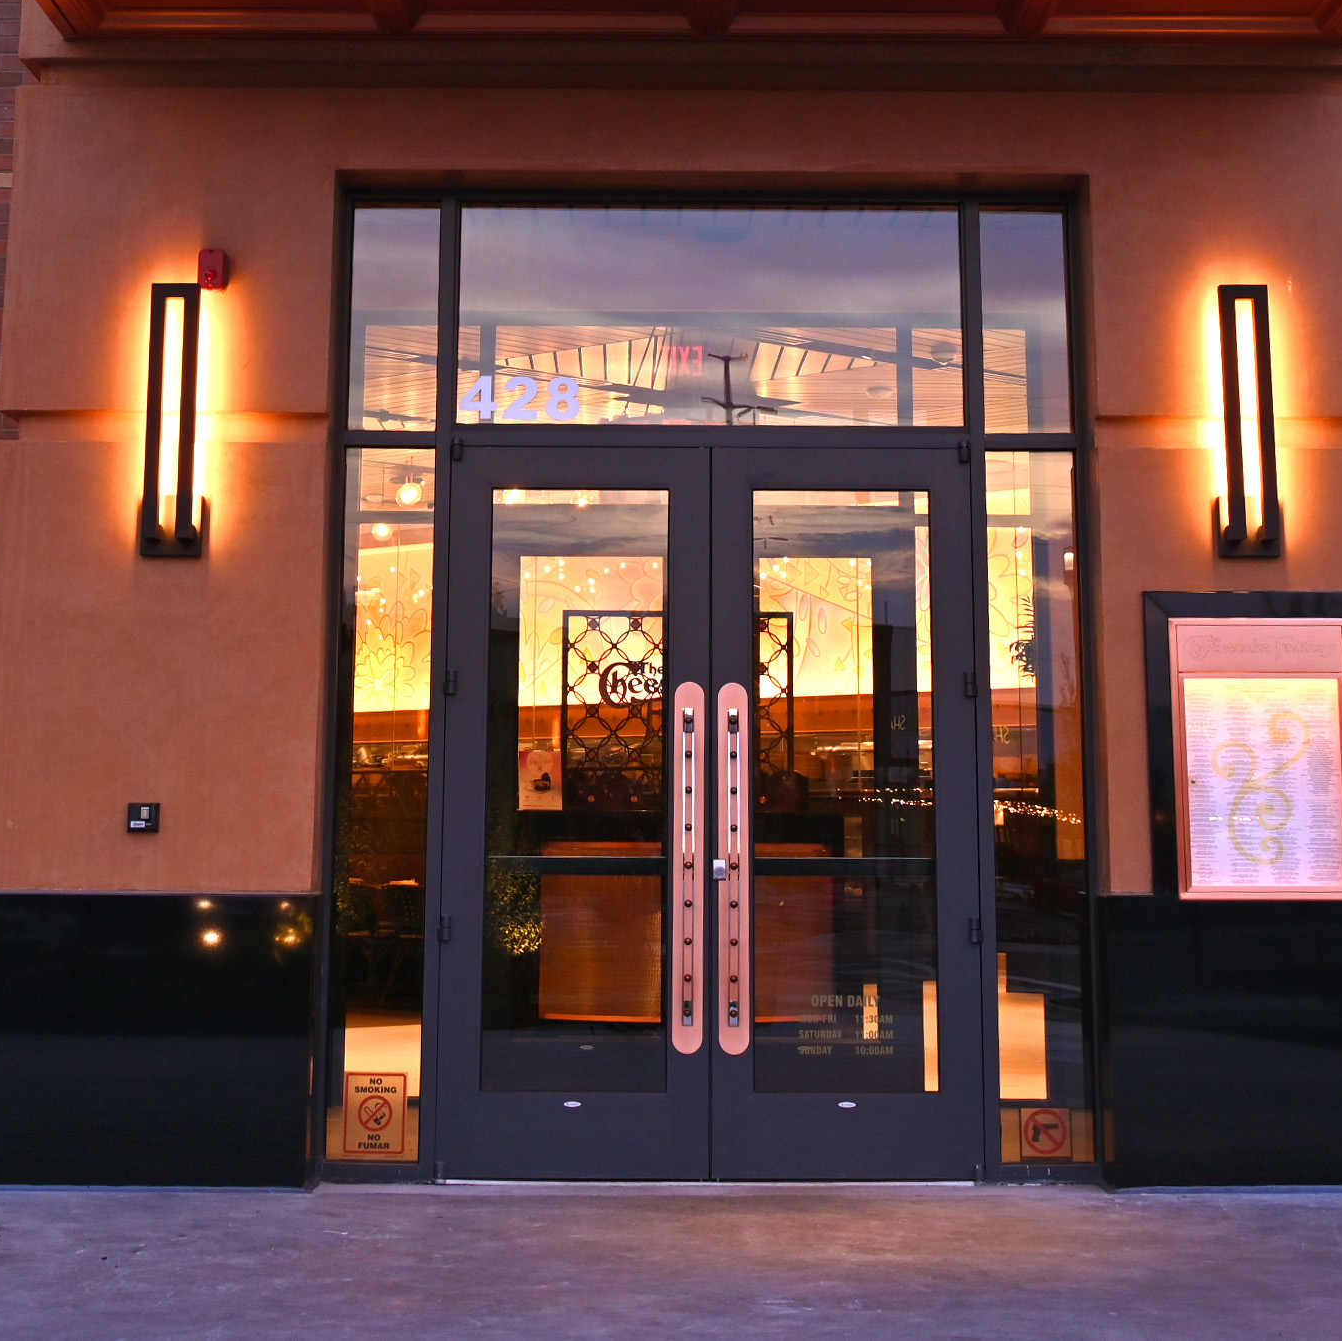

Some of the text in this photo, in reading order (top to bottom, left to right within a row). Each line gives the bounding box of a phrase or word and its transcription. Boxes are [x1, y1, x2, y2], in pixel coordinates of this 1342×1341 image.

[460, 375, 580, 420] 428
[811, 994, 880, 1007] OPEN DAILY
[799, 1014, 893, 1024] MON-FRI 11:30AM
[798, 1029, 893, 1039] SATURDAY 11:00AM
[798, 1046, 894, 1055] SUNDAY 10:00AM
[354, 1086, 397, 1094] SMOKING
[357, 1142, 390, 1150] FUMAR
